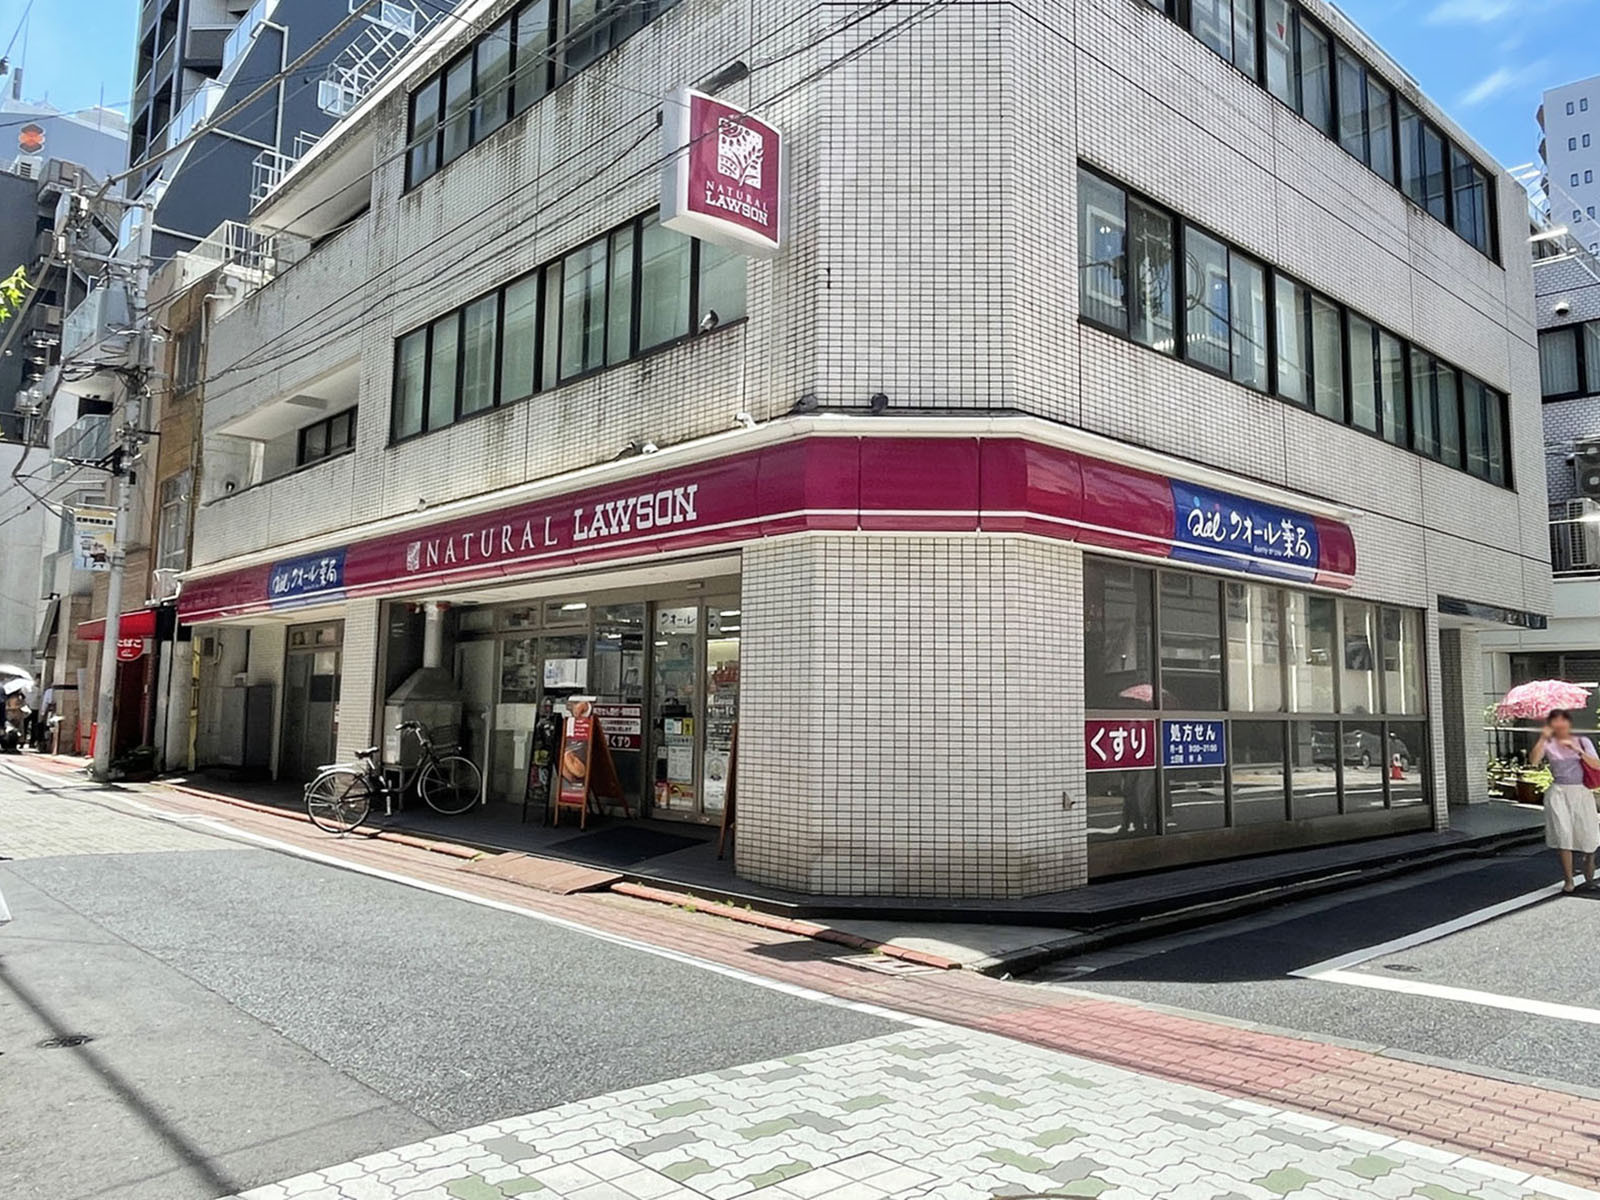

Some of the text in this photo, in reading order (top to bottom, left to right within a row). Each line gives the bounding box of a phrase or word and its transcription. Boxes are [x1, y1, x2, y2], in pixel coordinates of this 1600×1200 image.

[705, 191, 769, 227] LAWSON
[706, 181, 769, 213] NATURAL
[426, 484, 698, 567] NATURAL LAWSON
[1090, 726, 1146, 761] くすり
[1170, 723, 1216, 742] 処方せん
